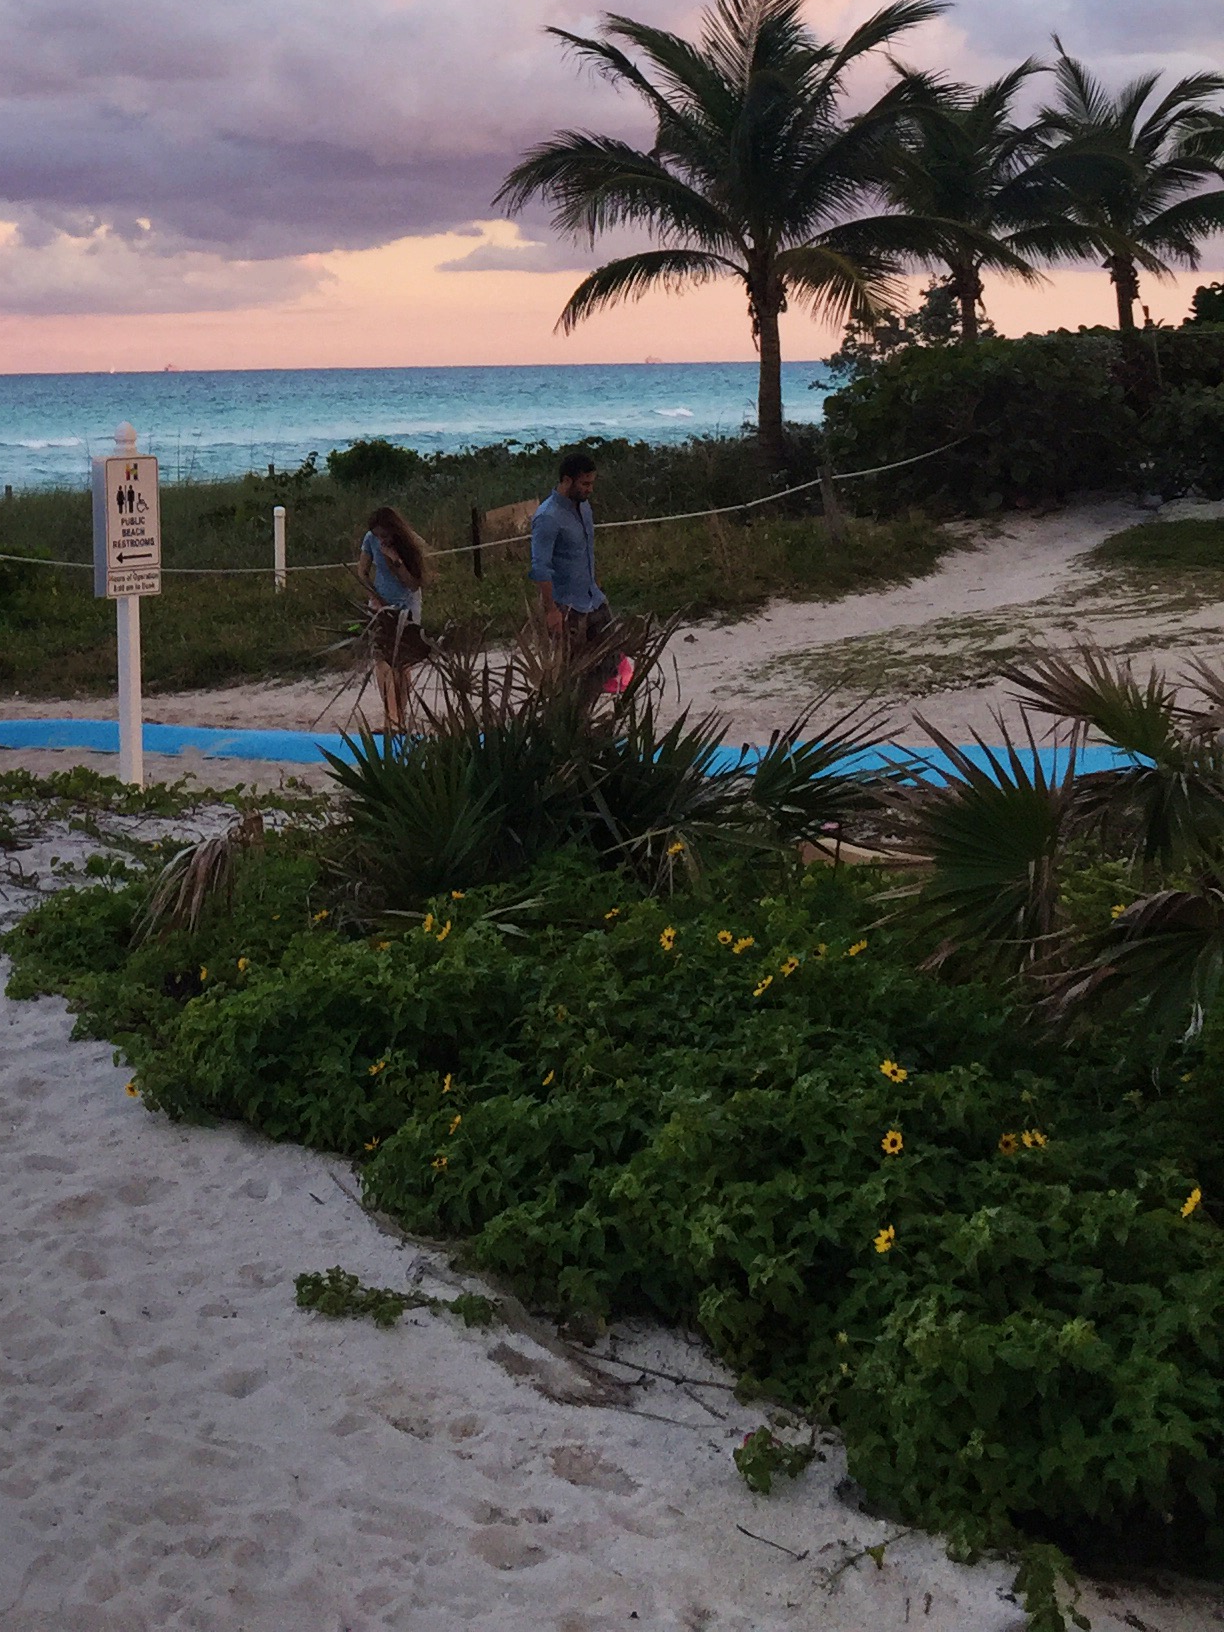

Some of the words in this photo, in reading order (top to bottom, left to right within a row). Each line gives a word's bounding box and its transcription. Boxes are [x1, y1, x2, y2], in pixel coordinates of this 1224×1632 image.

[121, 516, 145, 526] PUBLIC
[122, 528, 145, 537] BEACH
[112, 537, 155, 548] RESTROOMS
